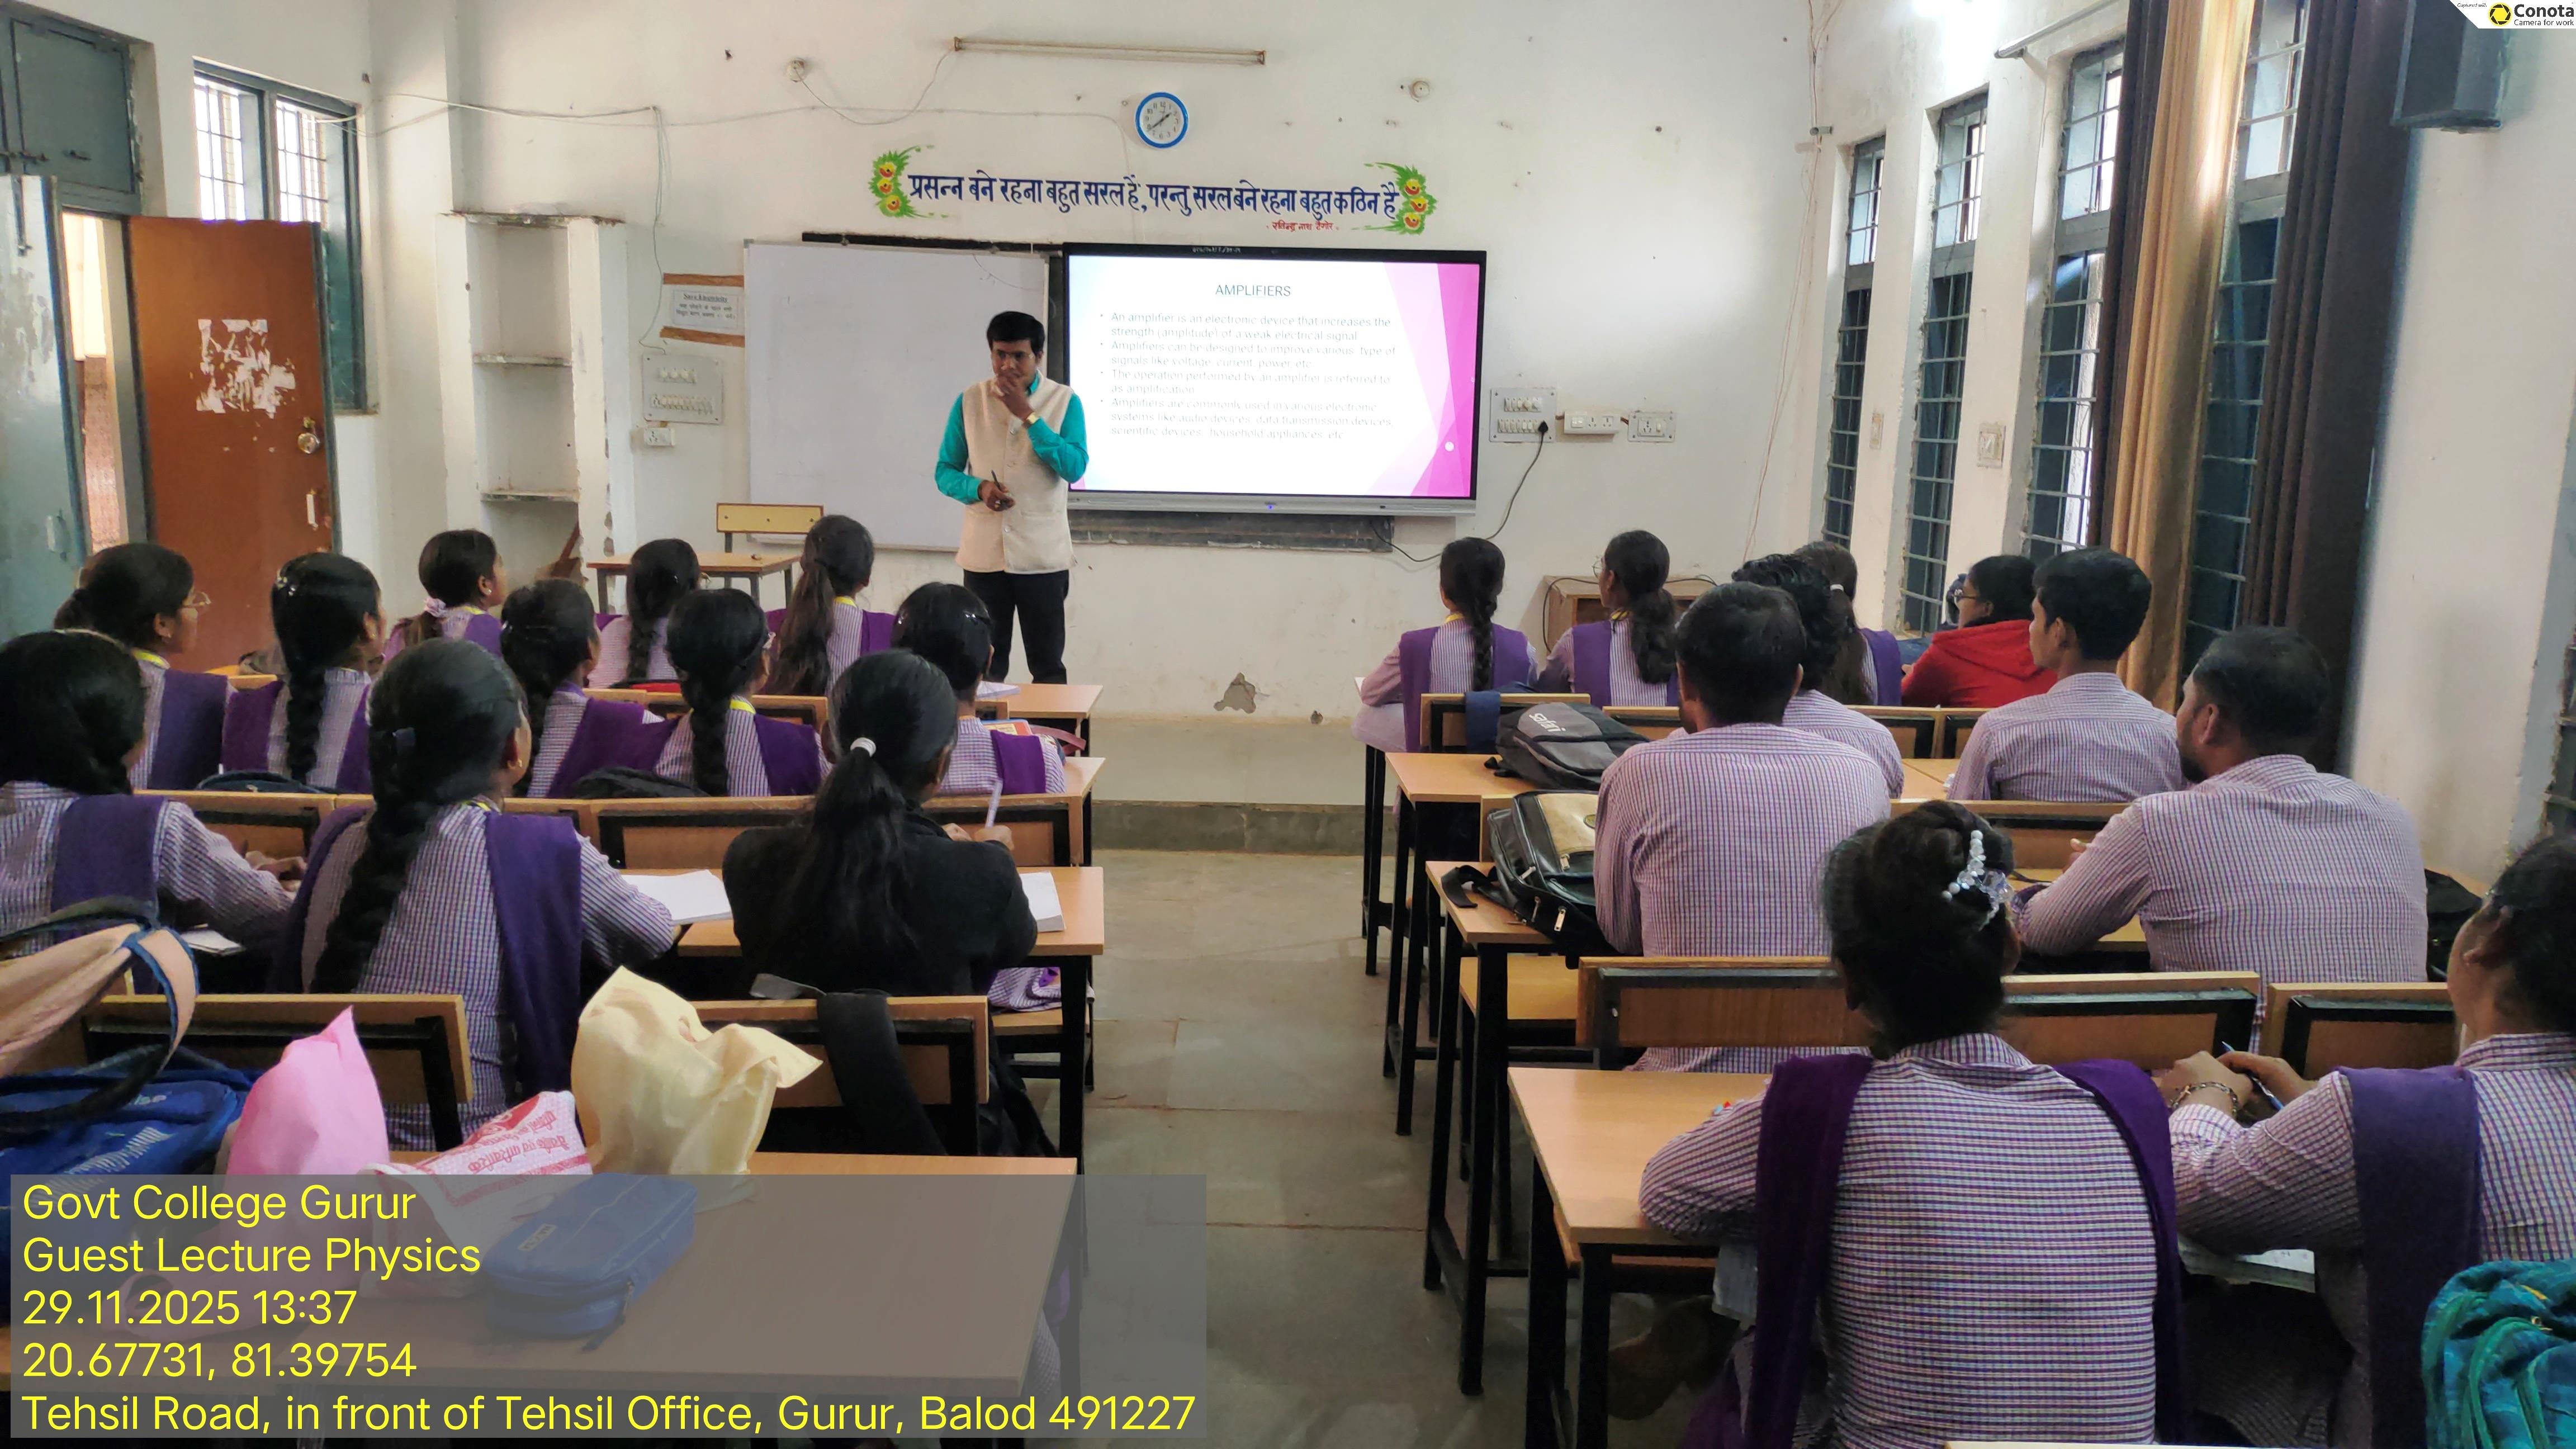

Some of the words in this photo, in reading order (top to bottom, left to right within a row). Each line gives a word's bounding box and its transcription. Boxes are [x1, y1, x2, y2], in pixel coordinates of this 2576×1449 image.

[907, 174, 964, 201] प्रसन्न
[968, 169, 997, 202] बने
[1000, 178, 1043, 204] रहना
[1046, 180, 1081, 214] बहुत
[1083, 181, 1125, 207] सरल
[1145, 184, 1191, 216] परन्तु
[1192, 186, 1233, 211] सरल
[1233, 179, 1260, 212] बने
[1261, 188, 1298, 215] रहना
[1300, 190, 1332, 220] बहुत
[1333, 186, 1380, 215] कठिन
[1381, 182, 1399, 220] है
[1215, 285, 1291, 297] AMPLIFIERS
[1111, 312, 1125, 322] An
[1128, 312, 1175, 324] amplifier
[1178, 314, 1186, 323] is
[1190, 315, 1202, 324] an
[1205, 314, 1257, 325] electronic
[1260, 315, 1295, 325] device
[1298, 316, 1318, 326] that
[1321, 317, 1371, 327] increases
[1375, 318, 1391, 327] the
[1111, 328, 1154, 339] strength
[1221, 329, 1232, 338] of
[1245, 330, 1271, 339] weak
[1275, 331, 1323, 340] electrical
[1111, 340, 1164, 353] Amplifiers
[1168, 343, 1187, 352] can
[1190, 343, 1202, 352] be
[1206, 343, 1254, 354] designed
[1257, 344, 1267, 353] to
[1271, 345, 1314, 356] improve
[1316, 345, 1355, 355] various
[1360, 345, 1382, 357] type
[1385, 344, 1396, 356] of
[1111, 355, 1149, 367] signals
[1151, 356, 1169, 365] like
[1111, 369, 1130, 379] The
[1134, 371, 1183, 381] operation
[1186, 371, 1241, 382] performed
[1244, 372, 1257, 382] by
[1259, 374, 1272, 382] an
[1275, 372, 1320, 384] amplifier
[1324, 375, 1333, 383] is
[1336, 374, 1377, 384] referred
[1380, 375, 1391, 385] to
[1111, 397, 1164, 409] Amplifiers
[1244, 400, 1270, 410] used
[1111, 411, 1155, 422] systems
[1157, 412, 1176, 422] like
[1256, 415, 1279, 424] data
